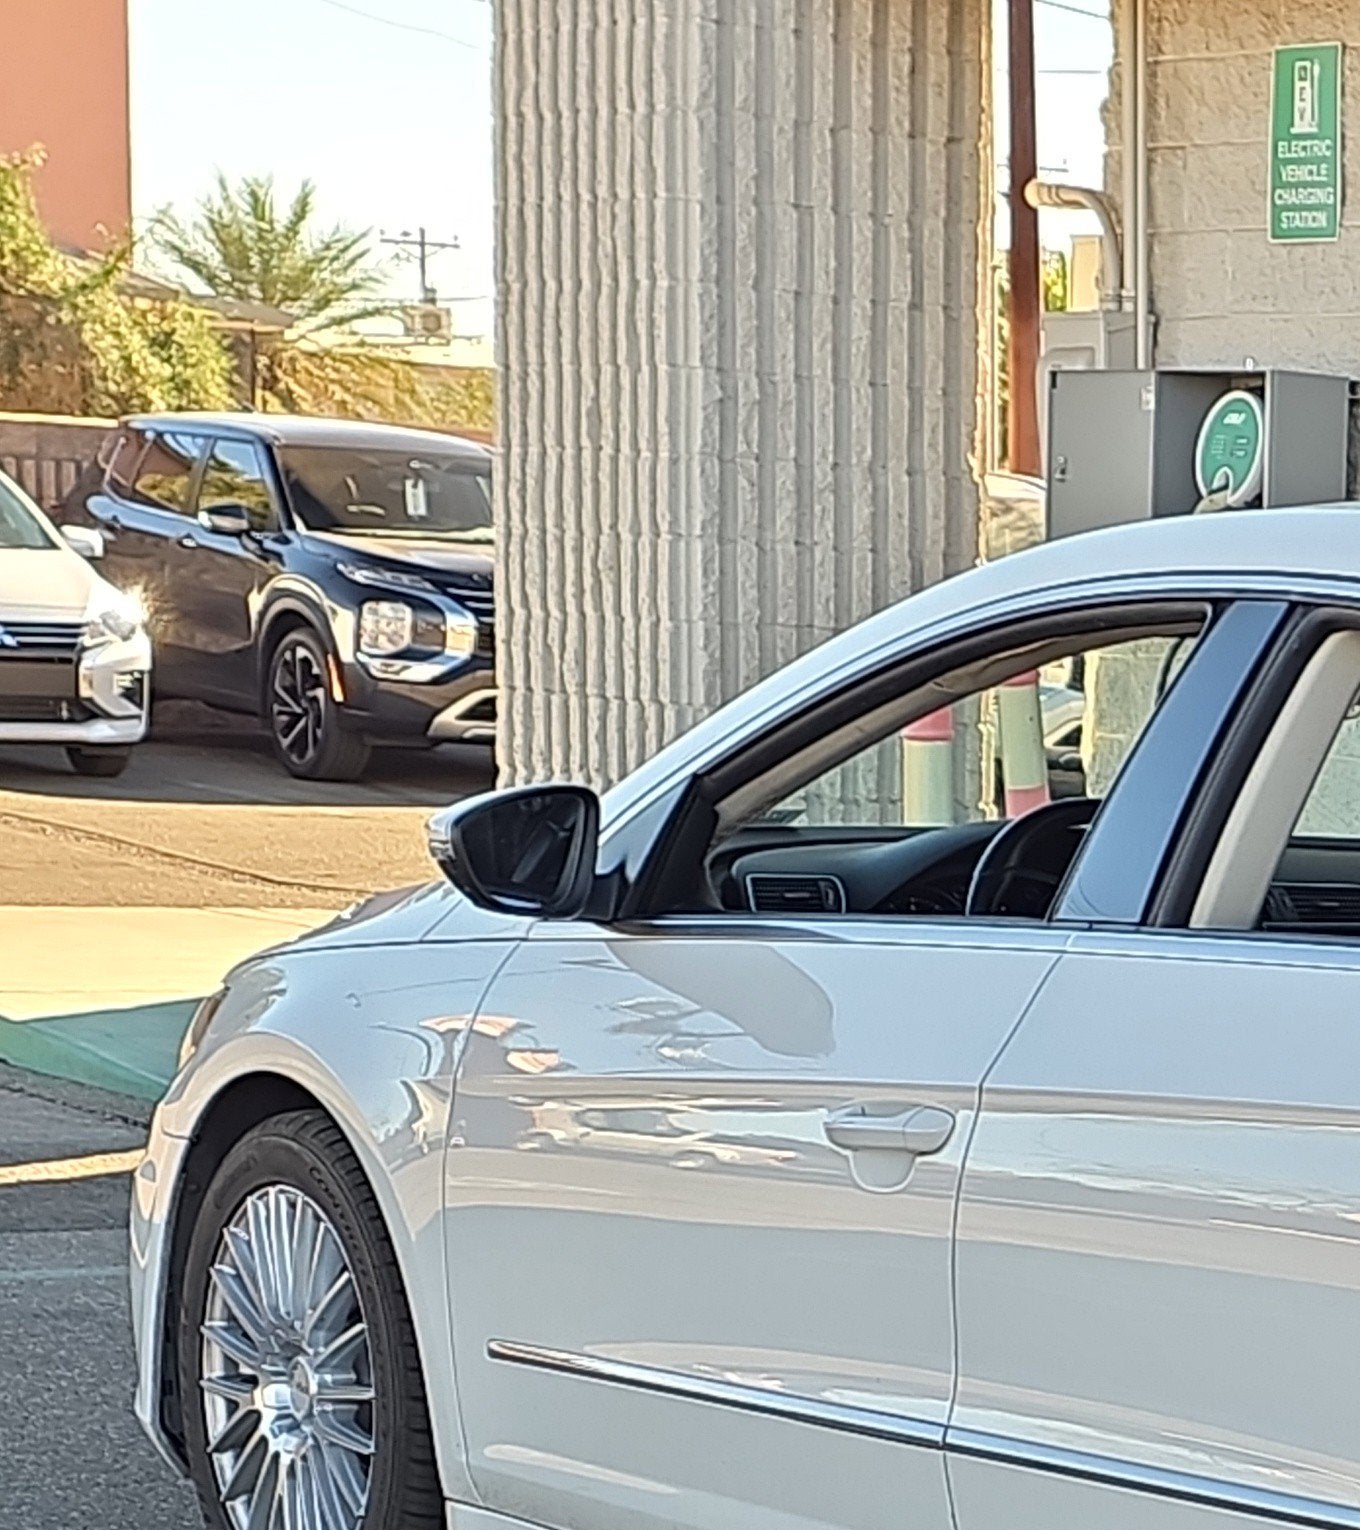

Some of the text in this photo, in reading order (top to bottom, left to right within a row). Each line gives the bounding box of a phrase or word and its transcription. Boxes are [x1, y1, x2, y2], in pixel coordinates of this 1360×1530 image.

[1277, 139, 1333, 158] ELECTRIC
[1279, 163, 1328, 182] VEHICLE
[1274, 187, 1334, 205] CHARGING
[1280, 211, 1327, 229] STATION
